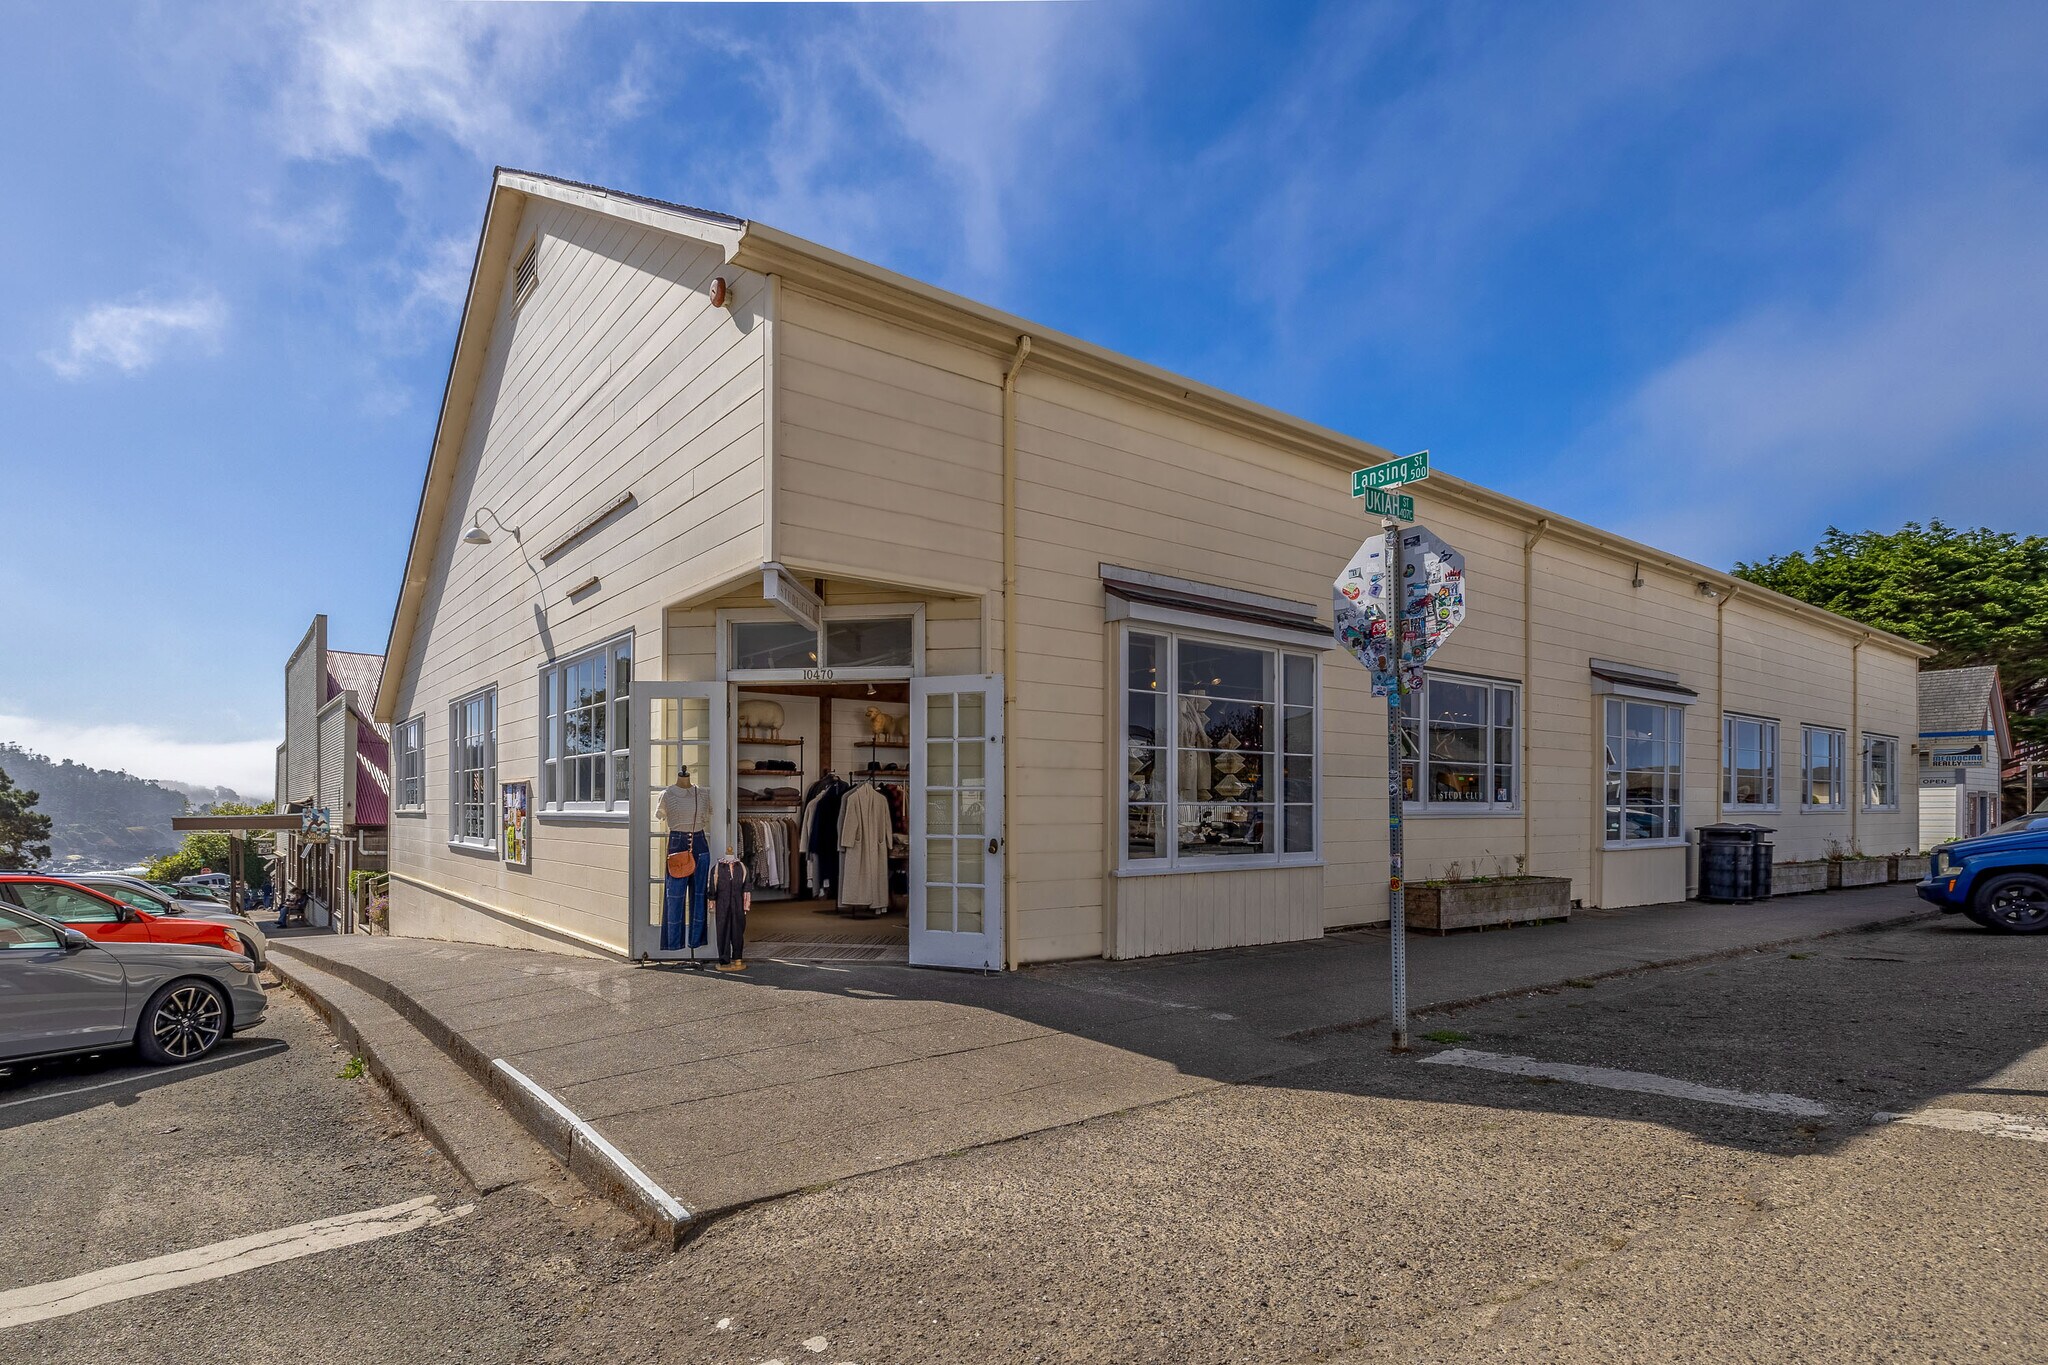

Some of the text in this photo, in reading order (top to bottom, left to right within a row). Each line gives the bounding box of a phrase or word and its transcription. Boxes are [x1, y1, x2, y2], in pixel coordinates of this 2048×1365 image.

[1354, 455, 1423, 490] Lansing St
[1411, 466, 1427, 480] 500
[1366, 490, 1410, 515] UKIAH ST
[803, 669, 834, 680] 10470
[1439, 791, 1462, 800] STUDY
